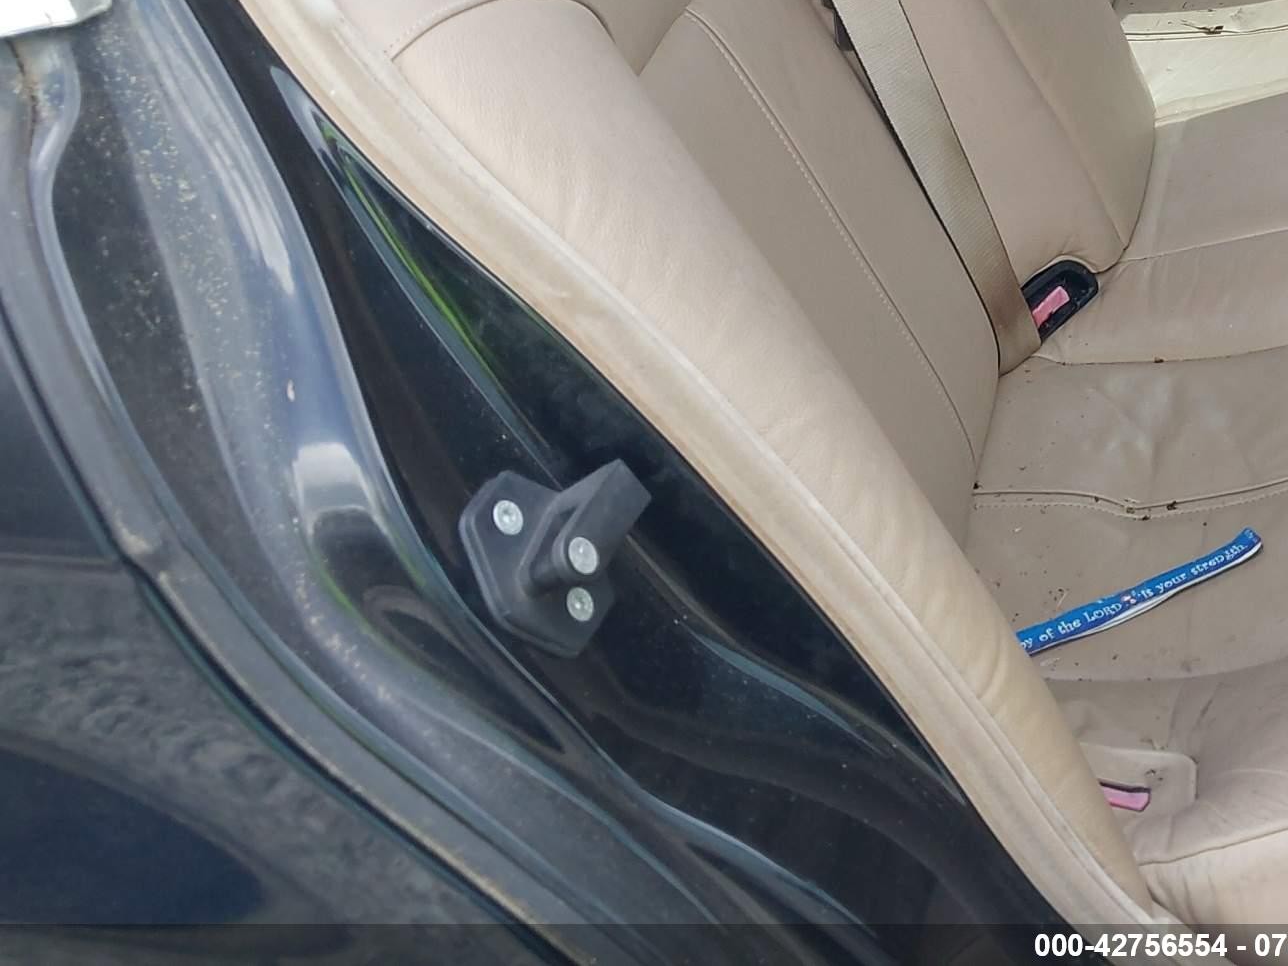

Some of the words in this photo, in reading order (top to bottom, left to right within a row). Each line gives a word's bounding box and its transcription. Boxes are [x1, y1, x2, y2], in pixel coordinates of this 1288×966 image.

[1039, 628, 1055, 642] of
[1057, 618, 1082, 635] the
[1083, 603, 1122, 622] LORD
[1142, 588, 1155, 599] is
[1155, 573, 1187, 593] your
